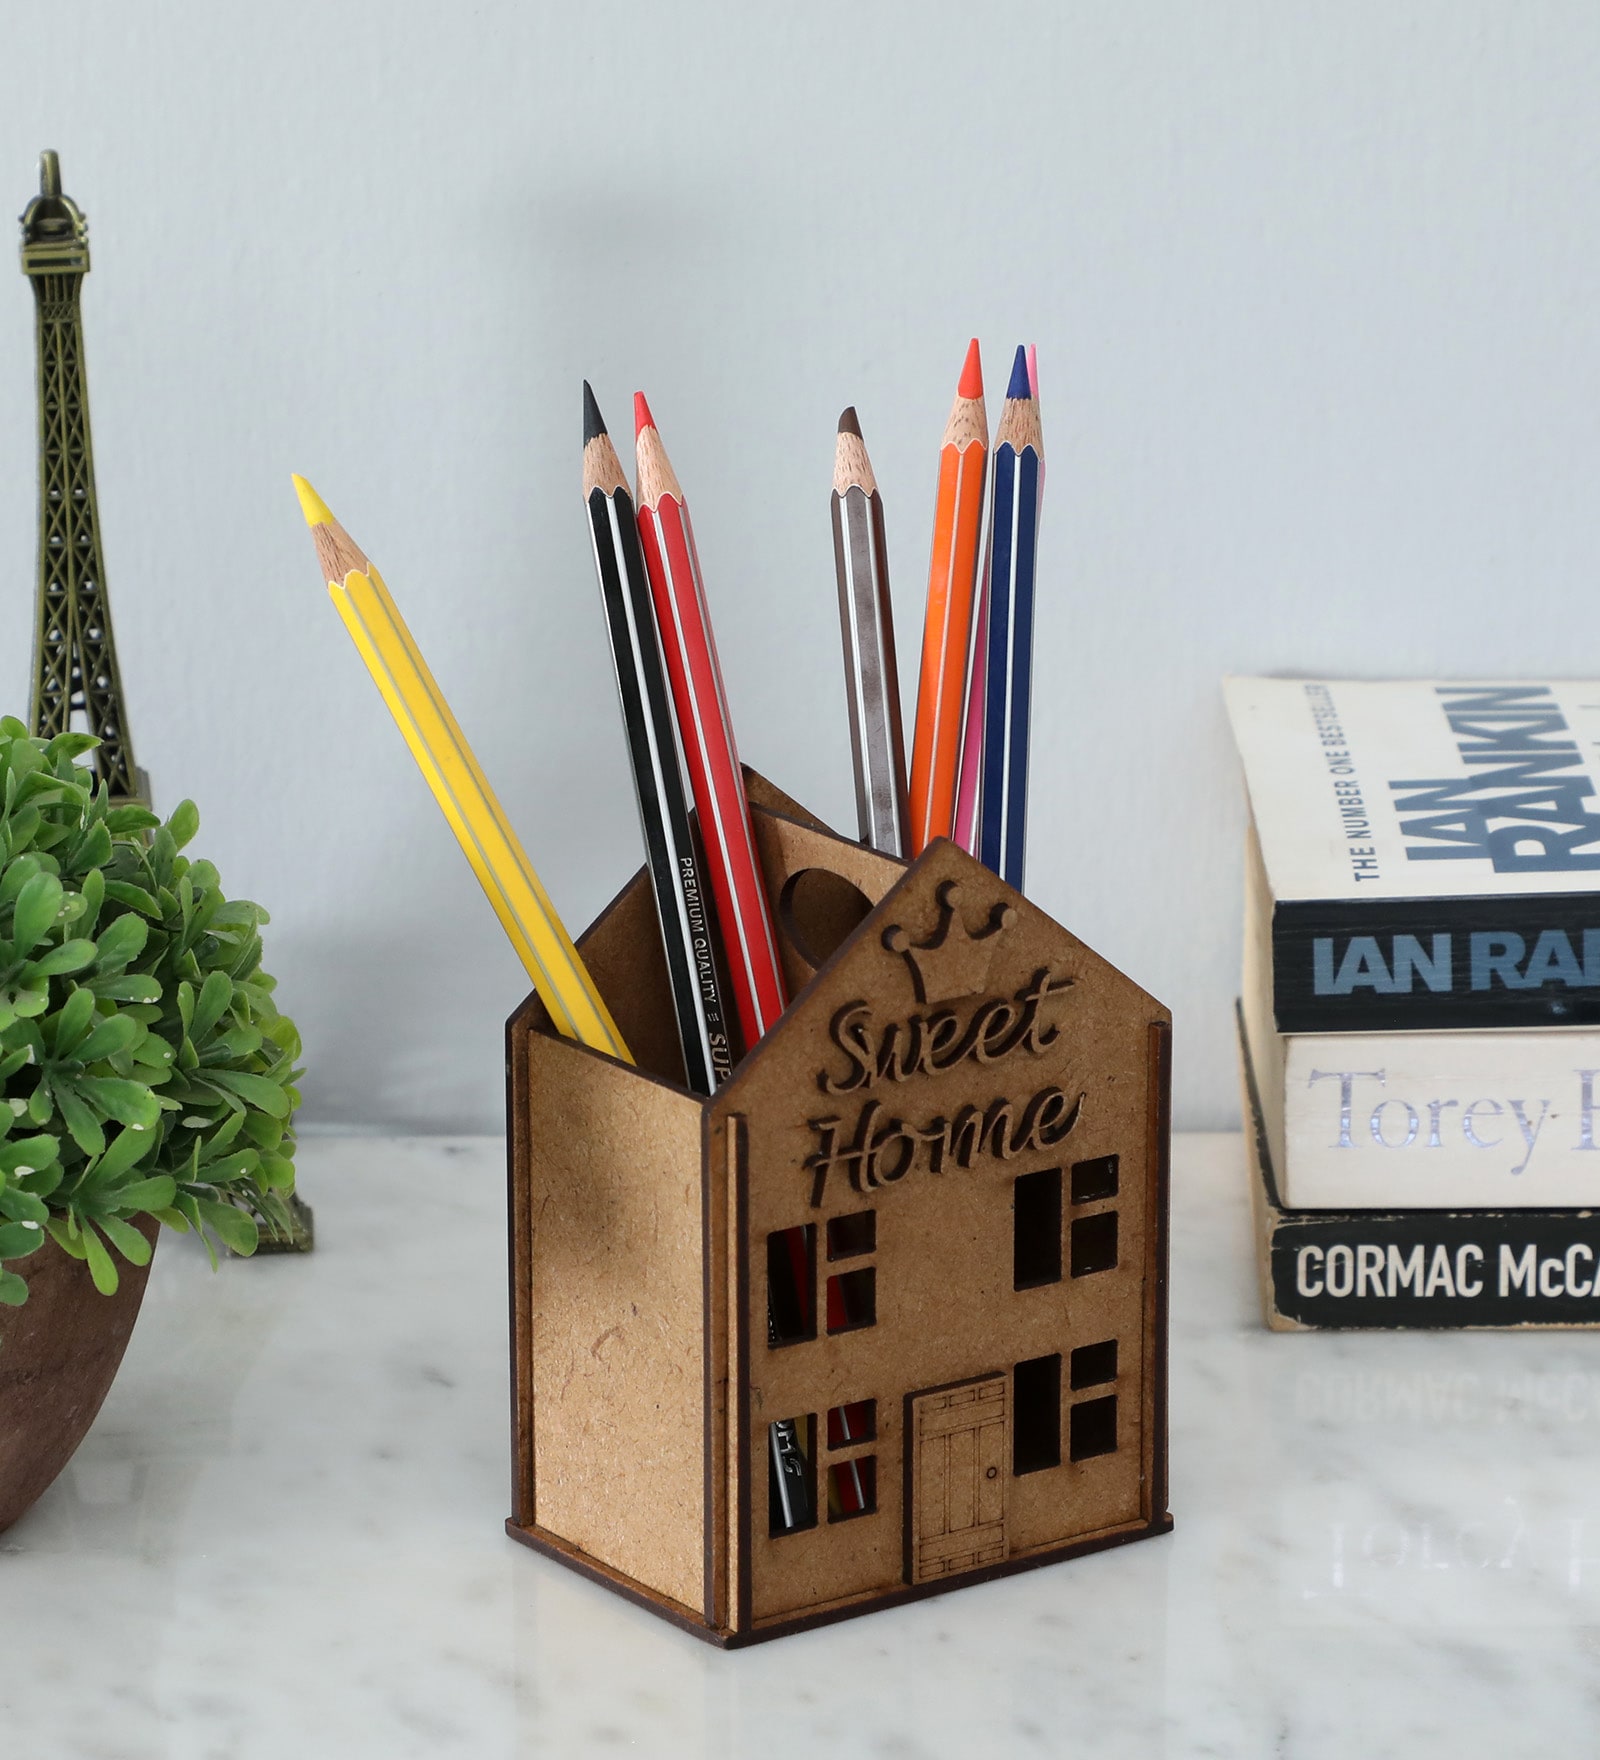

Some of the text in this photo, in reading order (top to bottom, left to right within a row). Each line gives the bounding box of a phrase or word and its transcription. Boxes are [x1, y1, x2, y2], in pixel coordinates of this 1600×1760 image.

[1304, 685, 1380, 882] THE NUMBER ONE BESTSELLER
[1388, 779, 1493, 860] IAN
[1435, 686, 1600, 873] RANKIN
[680, 857, 732, 1085] PREMIUM QUALITY SUP
[1313, 933, 1452, 995] IAN
[817, 968, 1075, 1094] Sweet
[805, 1087, 1085, 1207] Home
[1308, 1068, 1550, 1175] Torey
[1296, 1243, 1600, 1297] CORMAC McC
